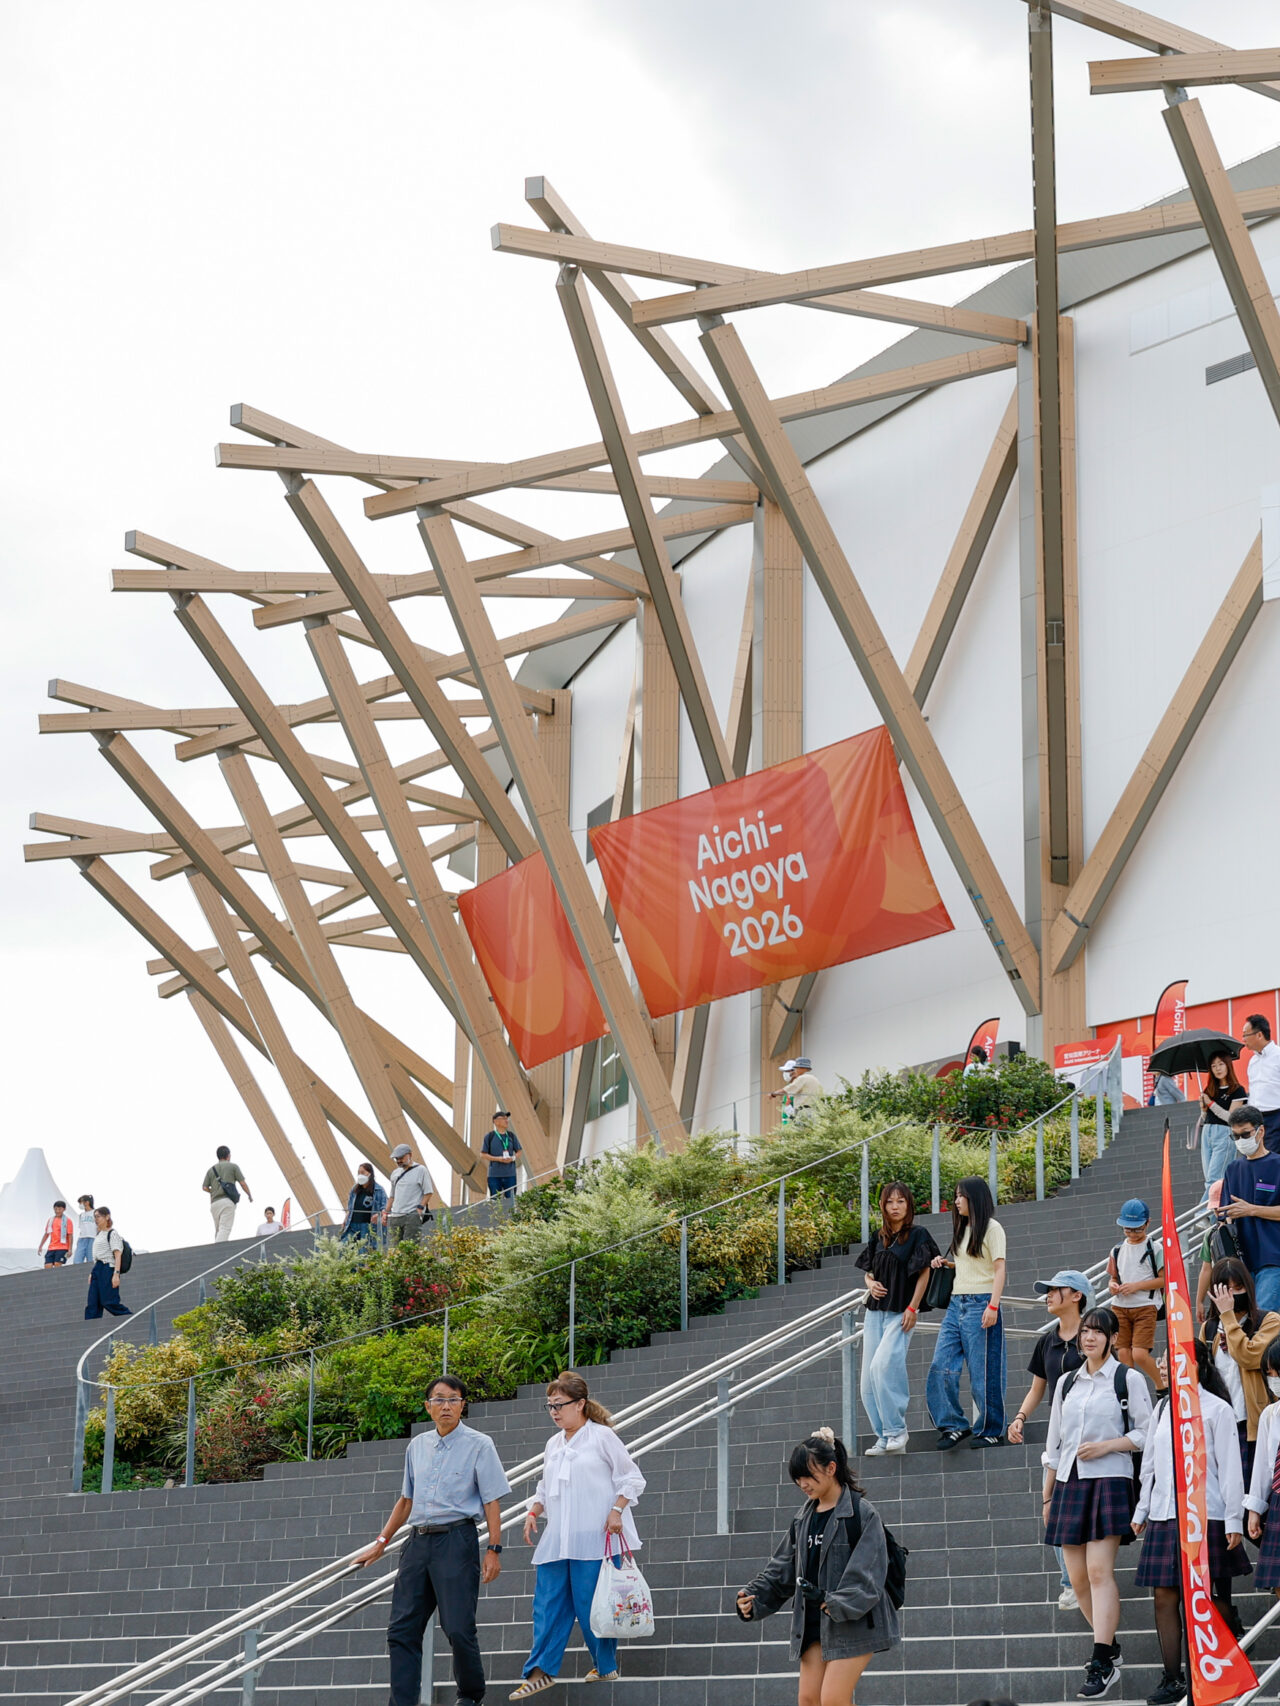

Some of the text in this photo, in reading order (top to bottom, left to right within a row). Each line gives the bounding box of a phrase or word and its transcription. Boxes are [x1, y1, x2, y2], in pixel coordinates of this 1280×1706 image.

[697, 810, 783, 870] Aichi-
[688, 851, 808, 913] Nagoya
[723, 904, 803, 957] 2026
[1190, 1560, 1233, 1682] 2026
